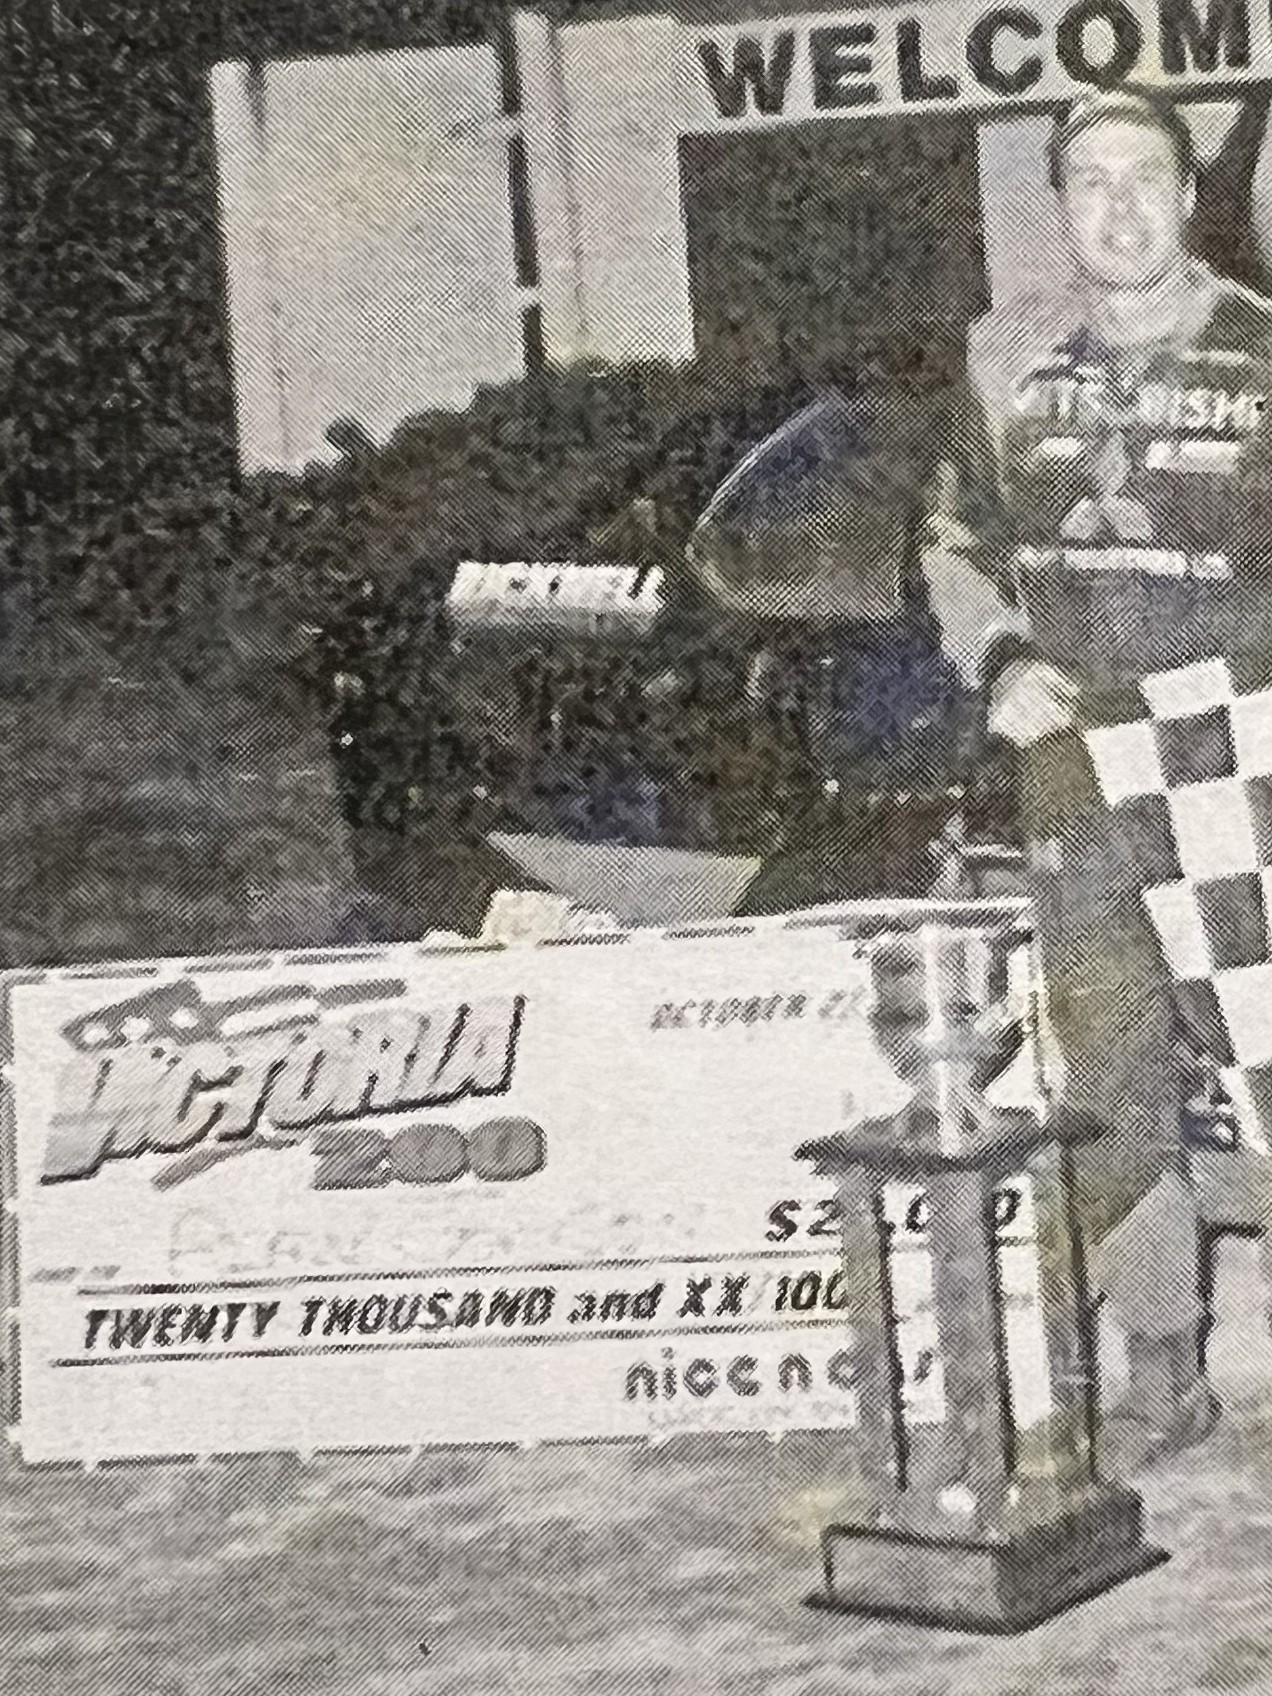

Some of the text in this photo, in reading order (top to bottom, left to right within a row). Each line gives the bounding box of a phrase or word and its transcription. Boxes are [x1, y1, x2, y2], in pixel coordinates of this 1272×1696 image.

[39, 994, 529, 1187] VICTORIA
[310, 1117, 548, 1191] 200
[83, 1299, 281, 1351] TWENTY
[297, 1286, 559, 1337] THOUSAND
[566, 1281, 667, 1323] and
